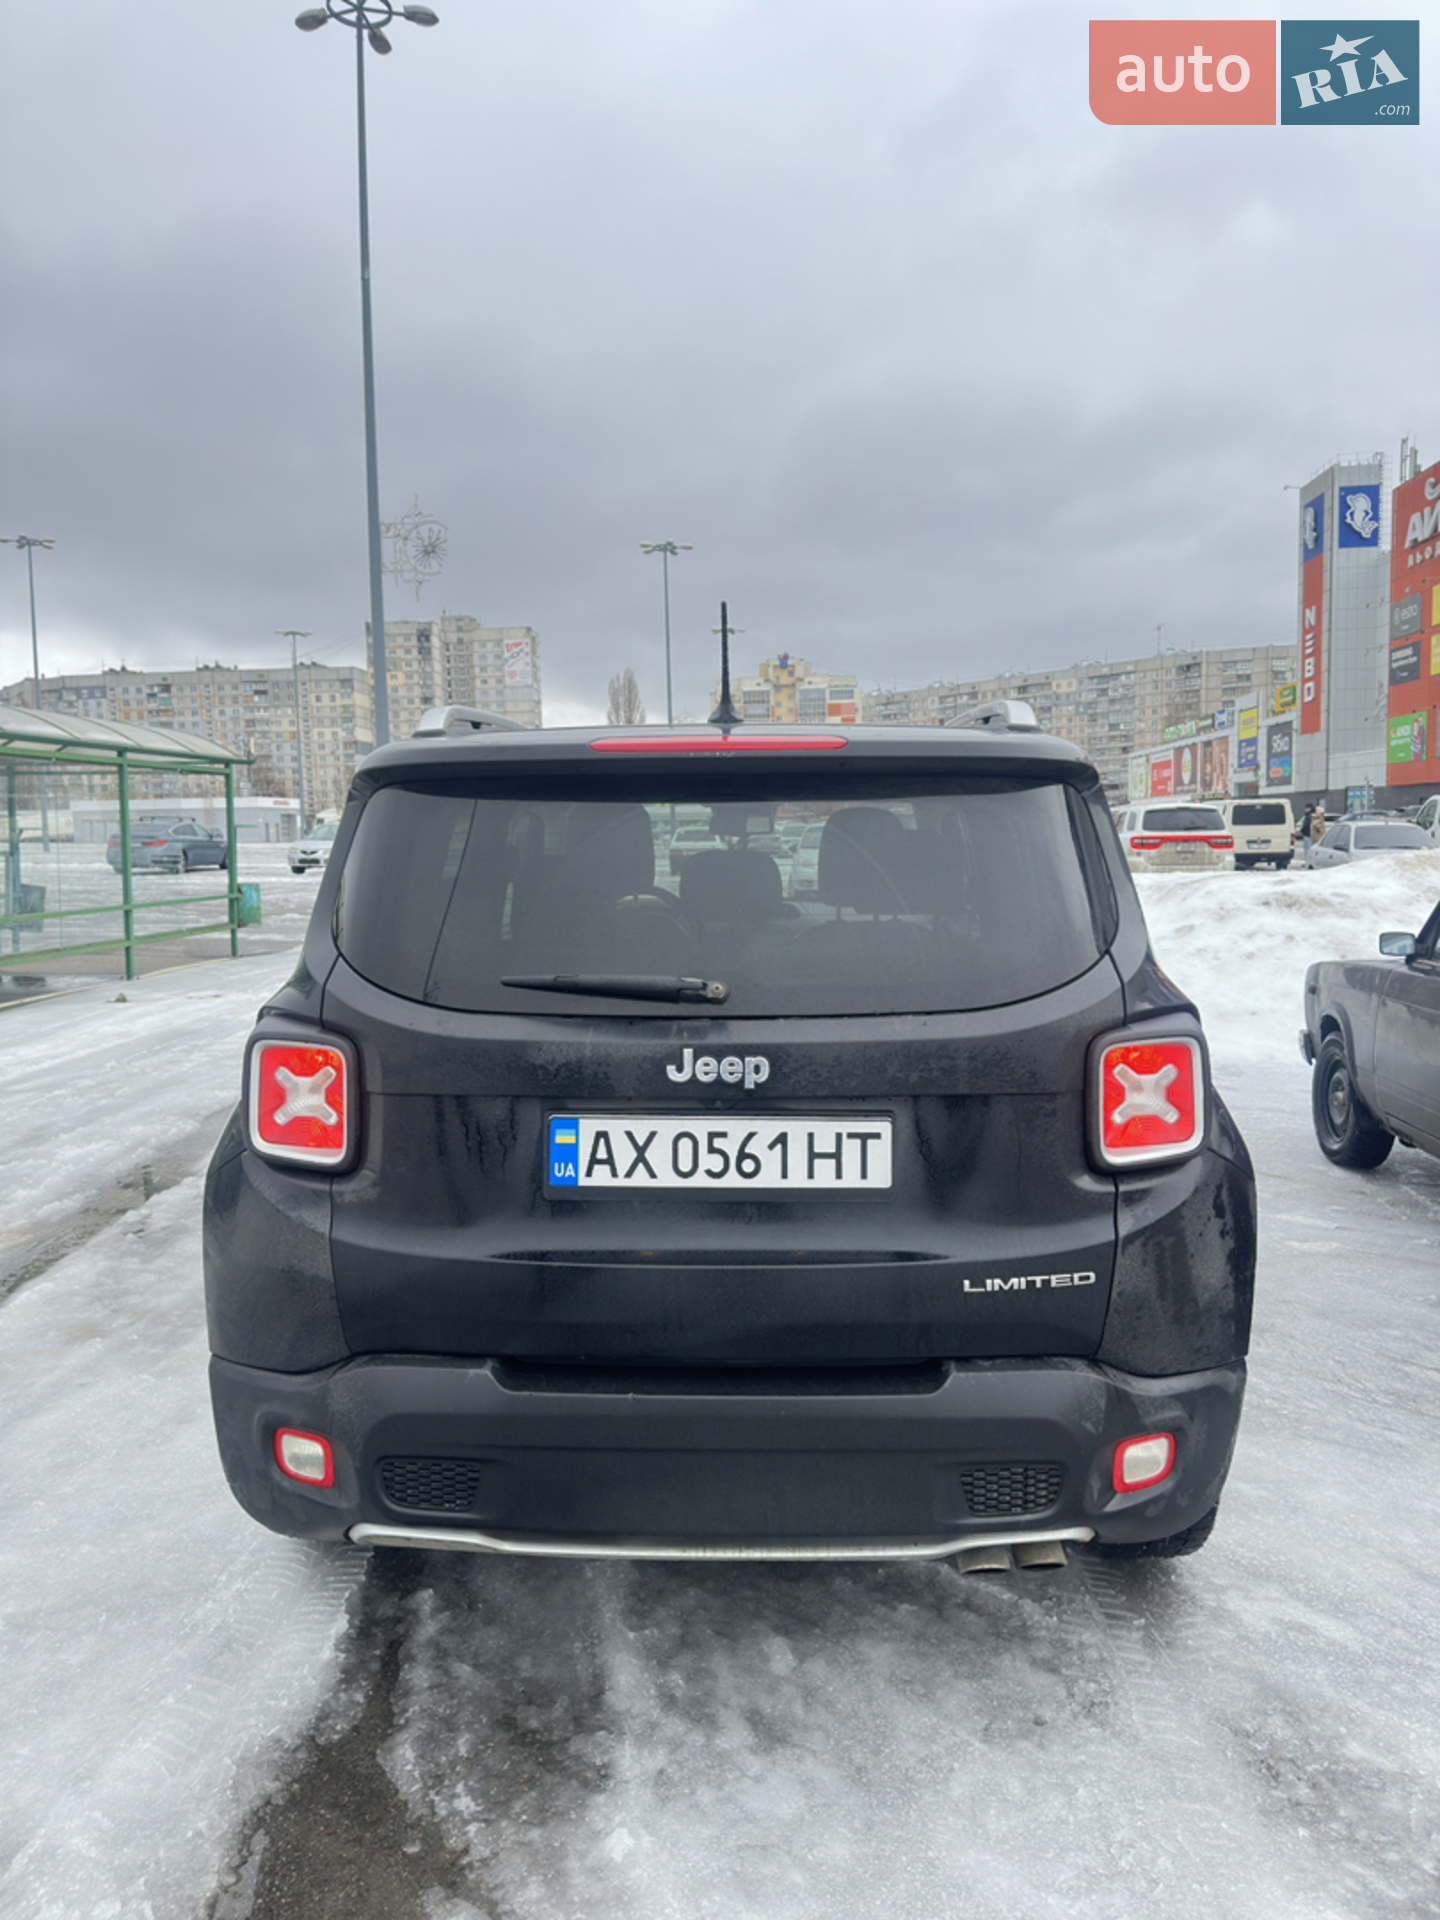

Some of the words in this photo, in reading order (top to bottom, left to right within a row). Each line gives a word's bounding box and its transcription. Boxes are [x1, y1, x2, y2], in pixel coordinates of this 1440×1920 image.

[666, 1048, 770, 1089] Jeep
[554, 1162, 577, 1178] UA
[584, 1130, 658, 1179] AX
[671, 1131, 789, 1179] 0561
[806, 1131, 882, 1180] HT
[963, 1271, 1096, 1293] LIMITED
